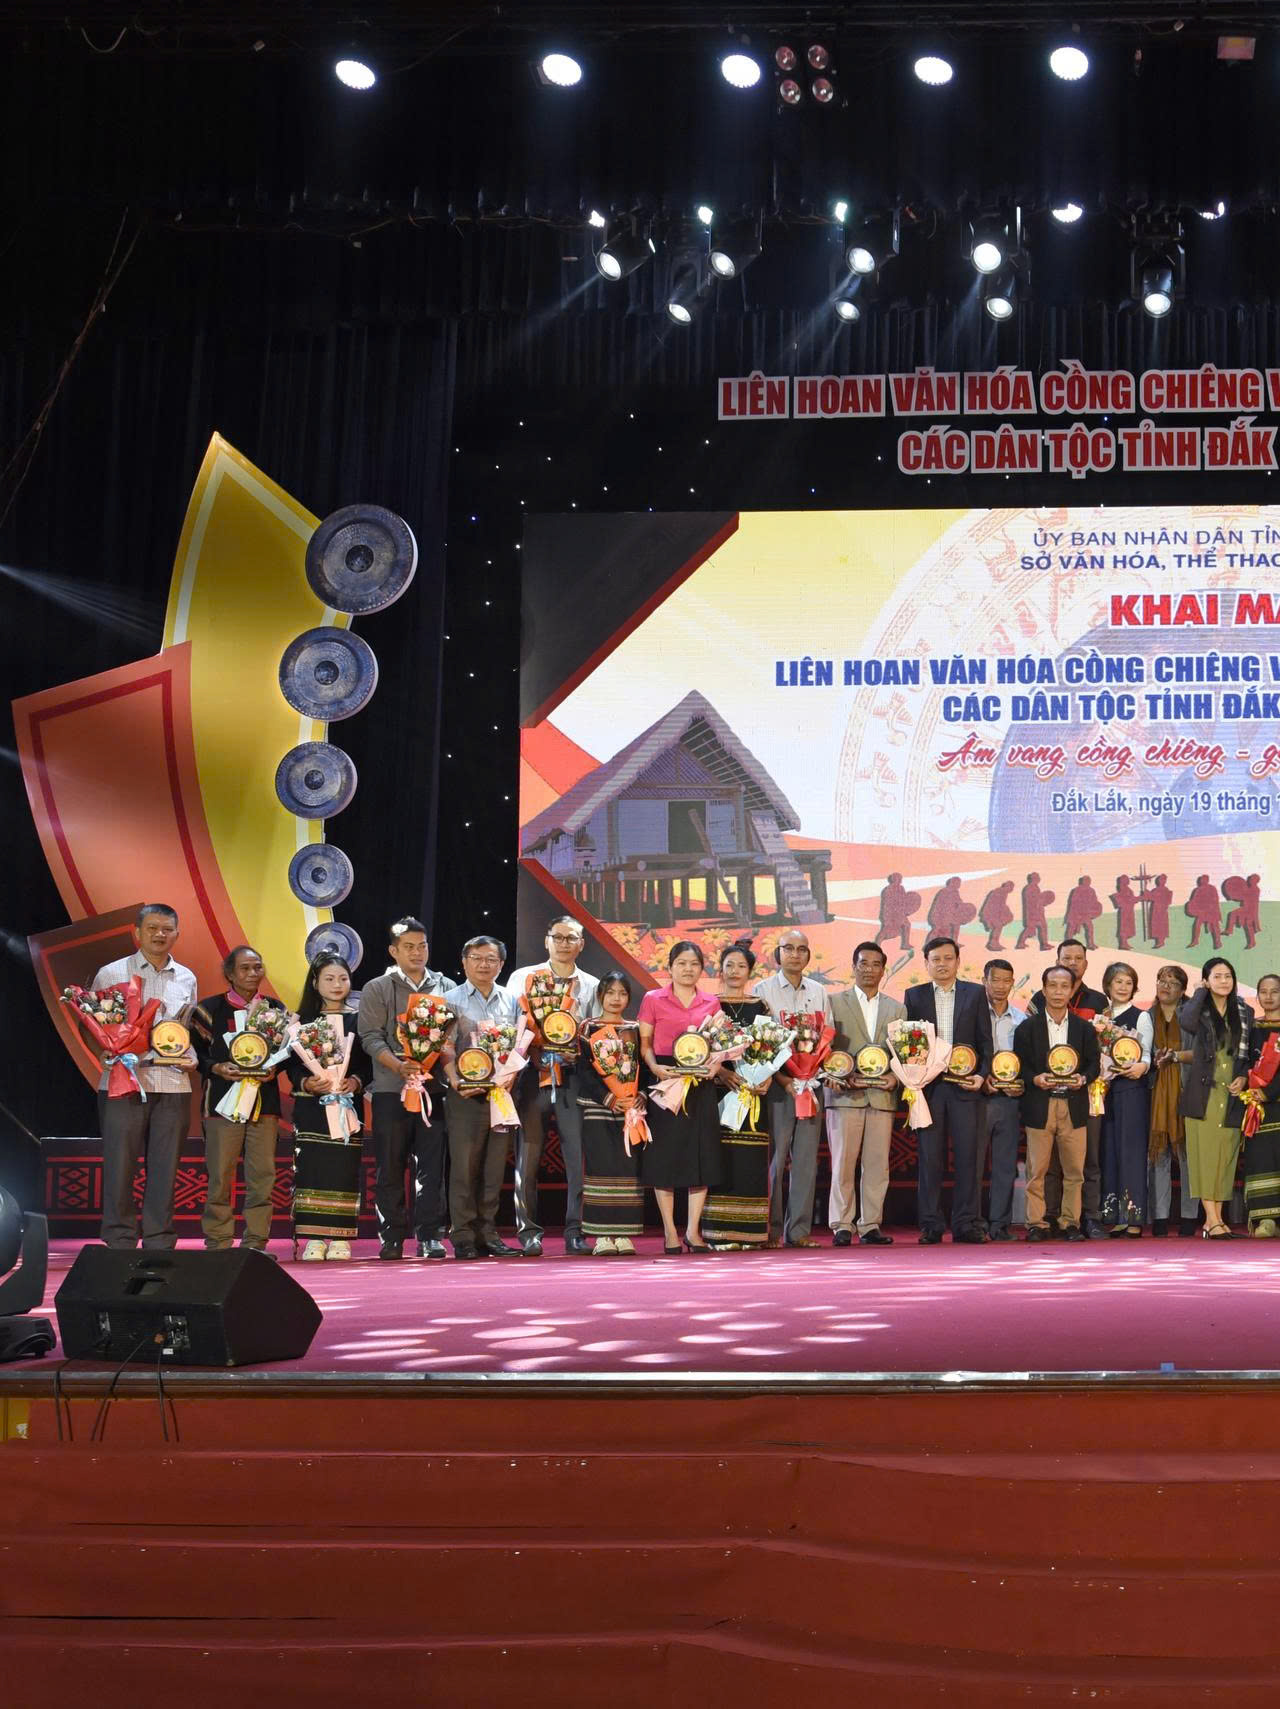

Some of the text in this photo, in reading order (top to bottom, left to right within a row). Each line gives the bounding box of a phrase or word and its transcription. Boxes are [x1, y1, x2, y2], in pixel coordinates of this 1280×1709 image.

[722, 375, 786, 416] LIÊN
[798, 379, 882, 415] HOAN
[893, 369, 956, 412] VĂN
[968, 368, 1032, 411] HÓA
[1045, 364, 1131, 410] CỒNG
[1145, 368, 1260, 409] CHIÊNG
[902, 428, 966, 470] CÁC
[975, 428, 1038, 469] DÂN
[1049, 427, 1113, 476] TỘC
[1123, 423, 1197, 467] TỈNH
[1208, 420, 1271, 467] ĐẮK
[1034, 528, 1063, 546] ỦY
[1072, 532, 1117, 546] BAN
[1124, 529, 1188, 545] NHÂN
[1197, 528, 1243, 544] DÂN
[1021, 551, 1052, 571] SỞ
[1060, 551, 1105, 569] VĂN
[1113, 550, 1166, 570] HÓA,
[1173, 547, 1217, 568] THỂ
[1111, 594, 1218, 626] KHAI
[776, 656, 833, 686] LIÊN
[844, 659, 920, 685] HOAN
[929, 655, 986, 685] VĂN
[997, 653, 1056, 684] HÓA
[1064, 650, 1143, 684] CỒNG
[1154, 652, 1259, 682] CHIÊNG
[943, 691, 1000, 722] CÁC
[1012, 690, 1069, 721] DÂN
[1078, 693, 1134, 726] TỘC
[1145, 689, 1211, 719] TỈNH
[1223, 686, 1280, 719] ĐẮK
[938, 731, 998, 767] Âm
[1007, 746, 1064, 776] vang
[1077, 735, 1133, 774] cồng
[1145, 738, 1223, 776] chiêng
[1052, 791, 1088, 812] Đắk
[1094, 790, 1132, 815] Lắk,
[1139, 794, 1184, 816] ngày
[1190, 793, 1211, 811] 19
[1217, 791, 1271, 815] tháng
